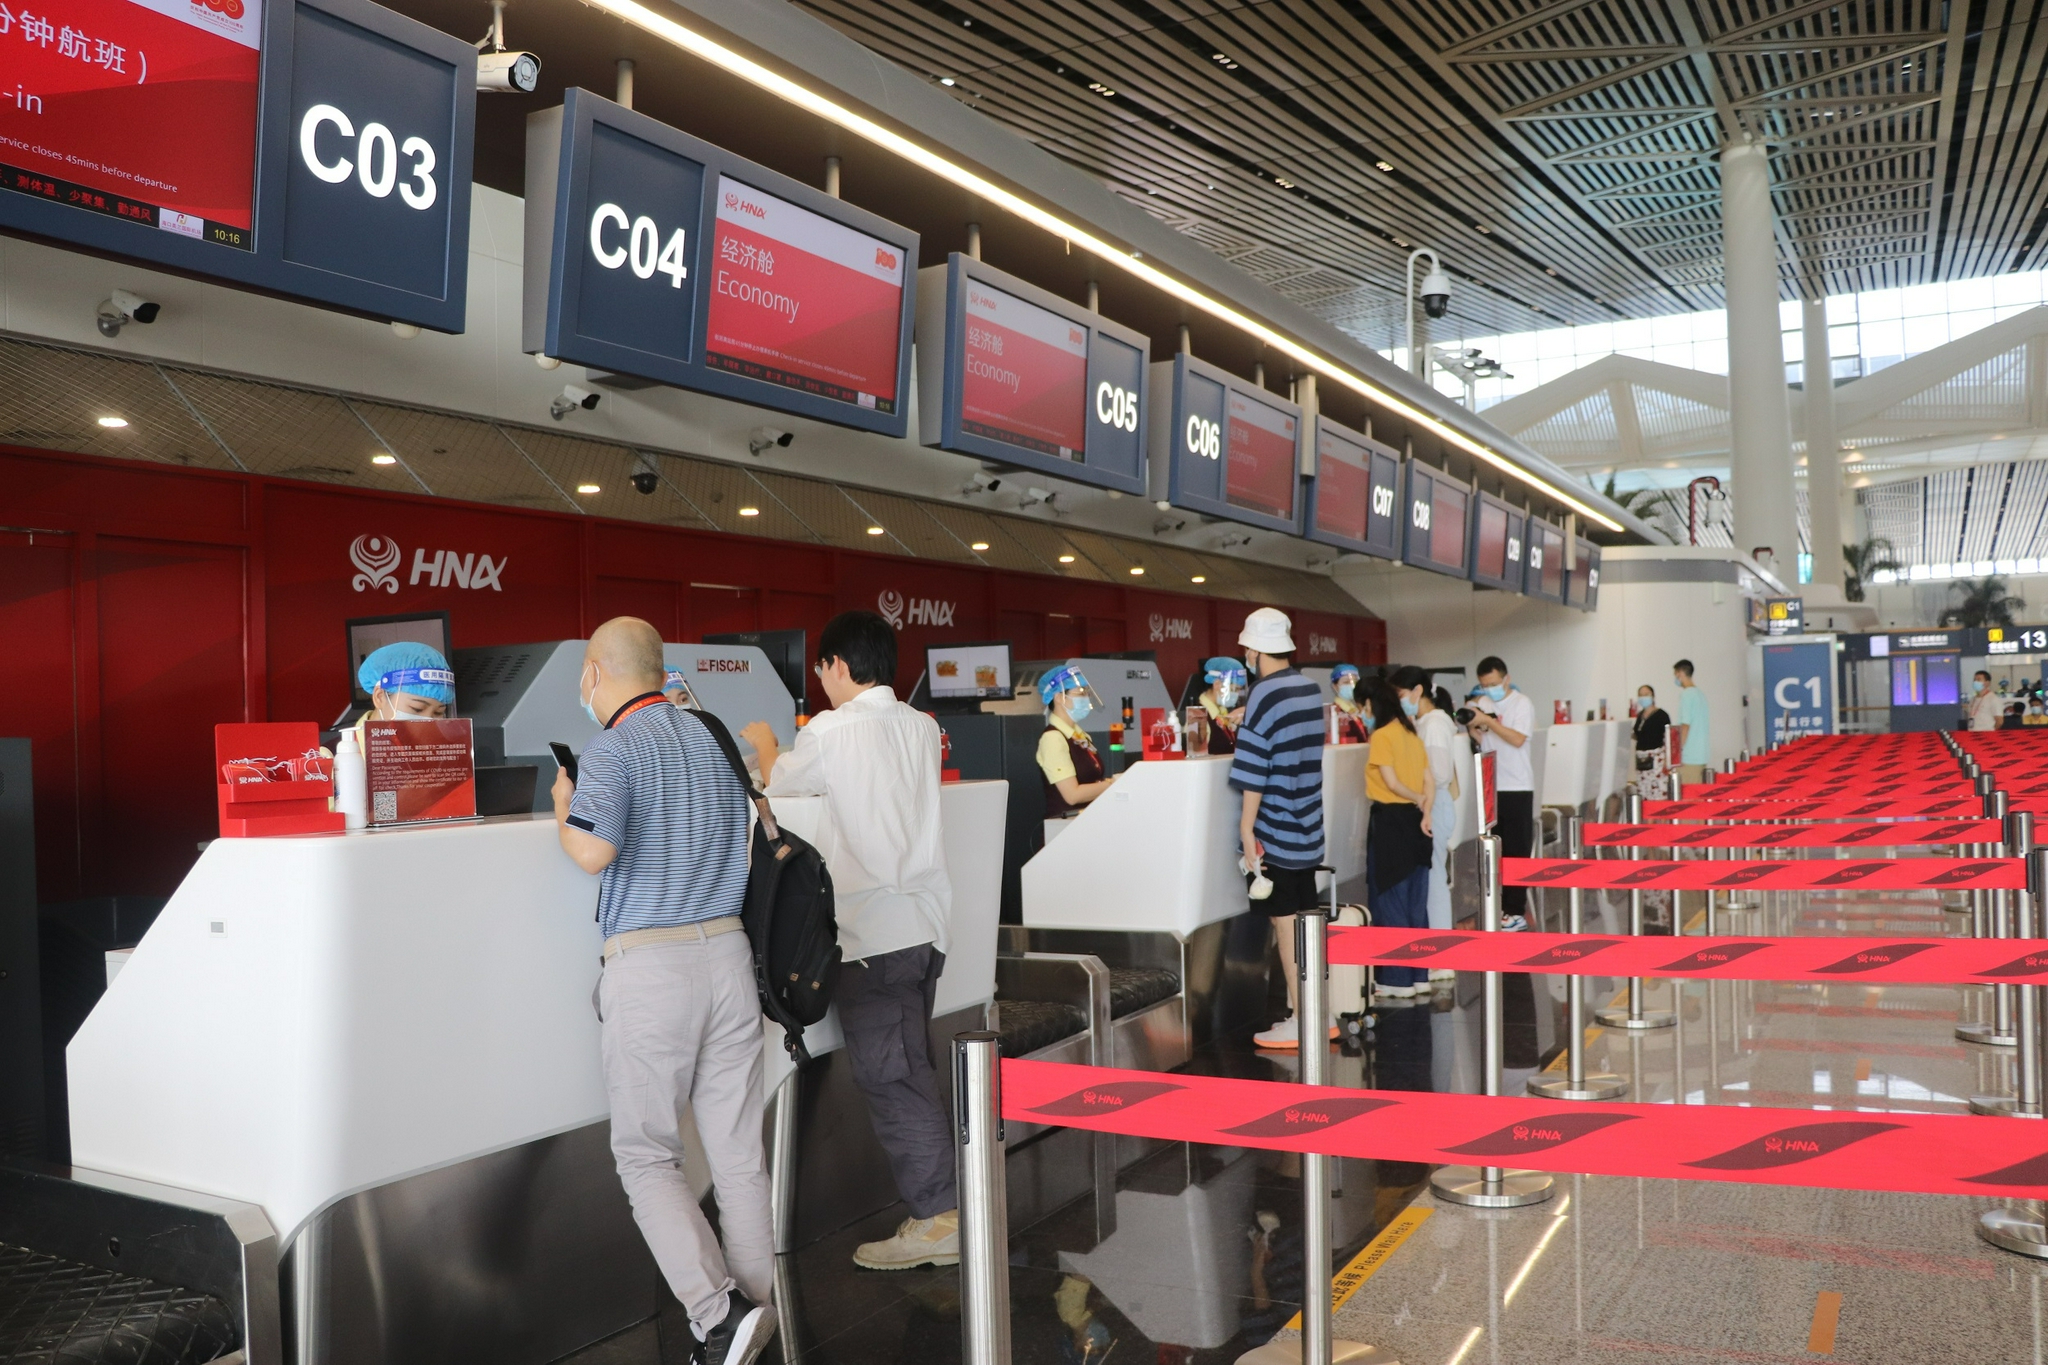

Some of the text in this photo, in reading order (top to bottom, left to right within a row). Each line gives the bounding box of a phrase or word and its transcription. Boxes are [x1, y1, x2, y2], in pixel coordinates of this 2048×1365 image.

[300, 104, 437, 210] C03
[31, 145, 63, 161] closes
[65, 154, 99, 171] 45mins
[101, 163, 132, 180] before
[134, 173, 178, 193] departure
[740, 201, 767, 220] HNA
[214, 229, 240, 244] 10:16
[590, 203, 688, 289] C04
[721, 236, 774, 277] 经济舱
[717, 272, 799, 323] Economy
[968, 326, 1003, 357] 经济舱
[966, 354, 1021, 394] Economy
[1097, 381, 1137, 433] C05
[1187, 415, 1220, 460] C06
[1373, 485, 1394, 517] C07
[409, 548, 508, 592] HNA
[908, 597, 956, 627] HNA
[1787, 601, 1800, 611] C1
[1165, 617, 1193, 640] HNA
[2020, 630, 2047, 649] 13
[1319, 636, 1338, 655] HNA
[709, 659, 750, 672] FISCAN
[1774, 676, 1821, 709] C1
[380, 728, 397, 736] HNA
[1420, 944, 1437, 952] HNA
[1562, 949, 1581, 957] HNA
[1708, 953, 1728, 961] HNA
[1097, 1094, 1124, 1106] HNA
[1301, 1111, 1331, 1124] HNA
[1531, 1129, 1563, 1141] HNA
[1785, 1140, 1820, 1152] HNA
[1354, 1249, 1386, 1271] Please
[1377, 1233, 1400, 1249] Wait
[1392, 1221, 1414, 1236] Here
